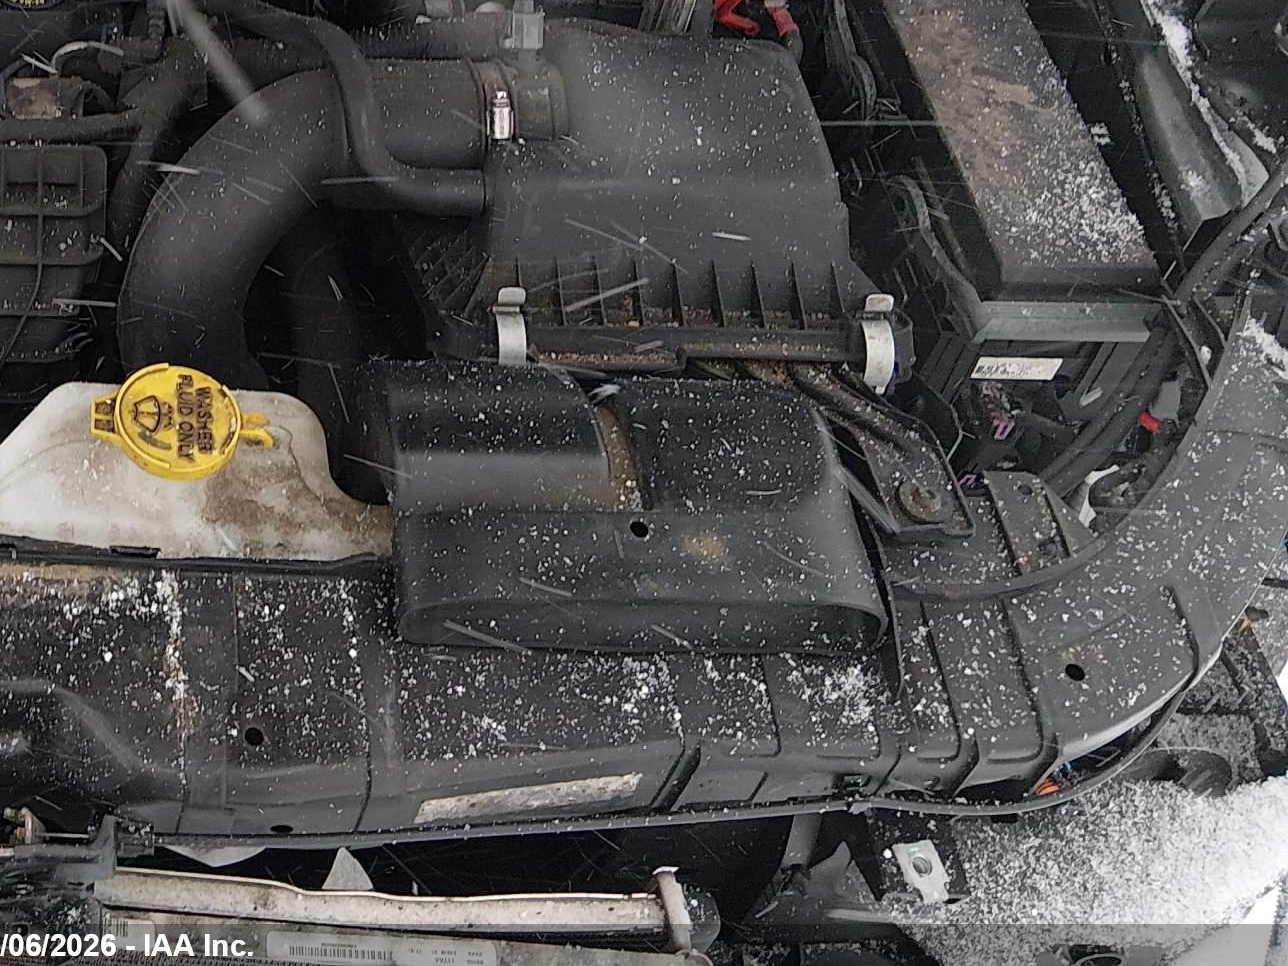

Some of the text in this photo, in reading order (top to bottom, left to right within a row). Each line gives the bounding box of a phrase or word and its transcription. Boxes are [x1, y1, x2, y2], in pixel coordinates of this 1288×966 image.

[176, 374, 195, 464] FLUID ONLY
[194, 386, 213, 454] WASHER
